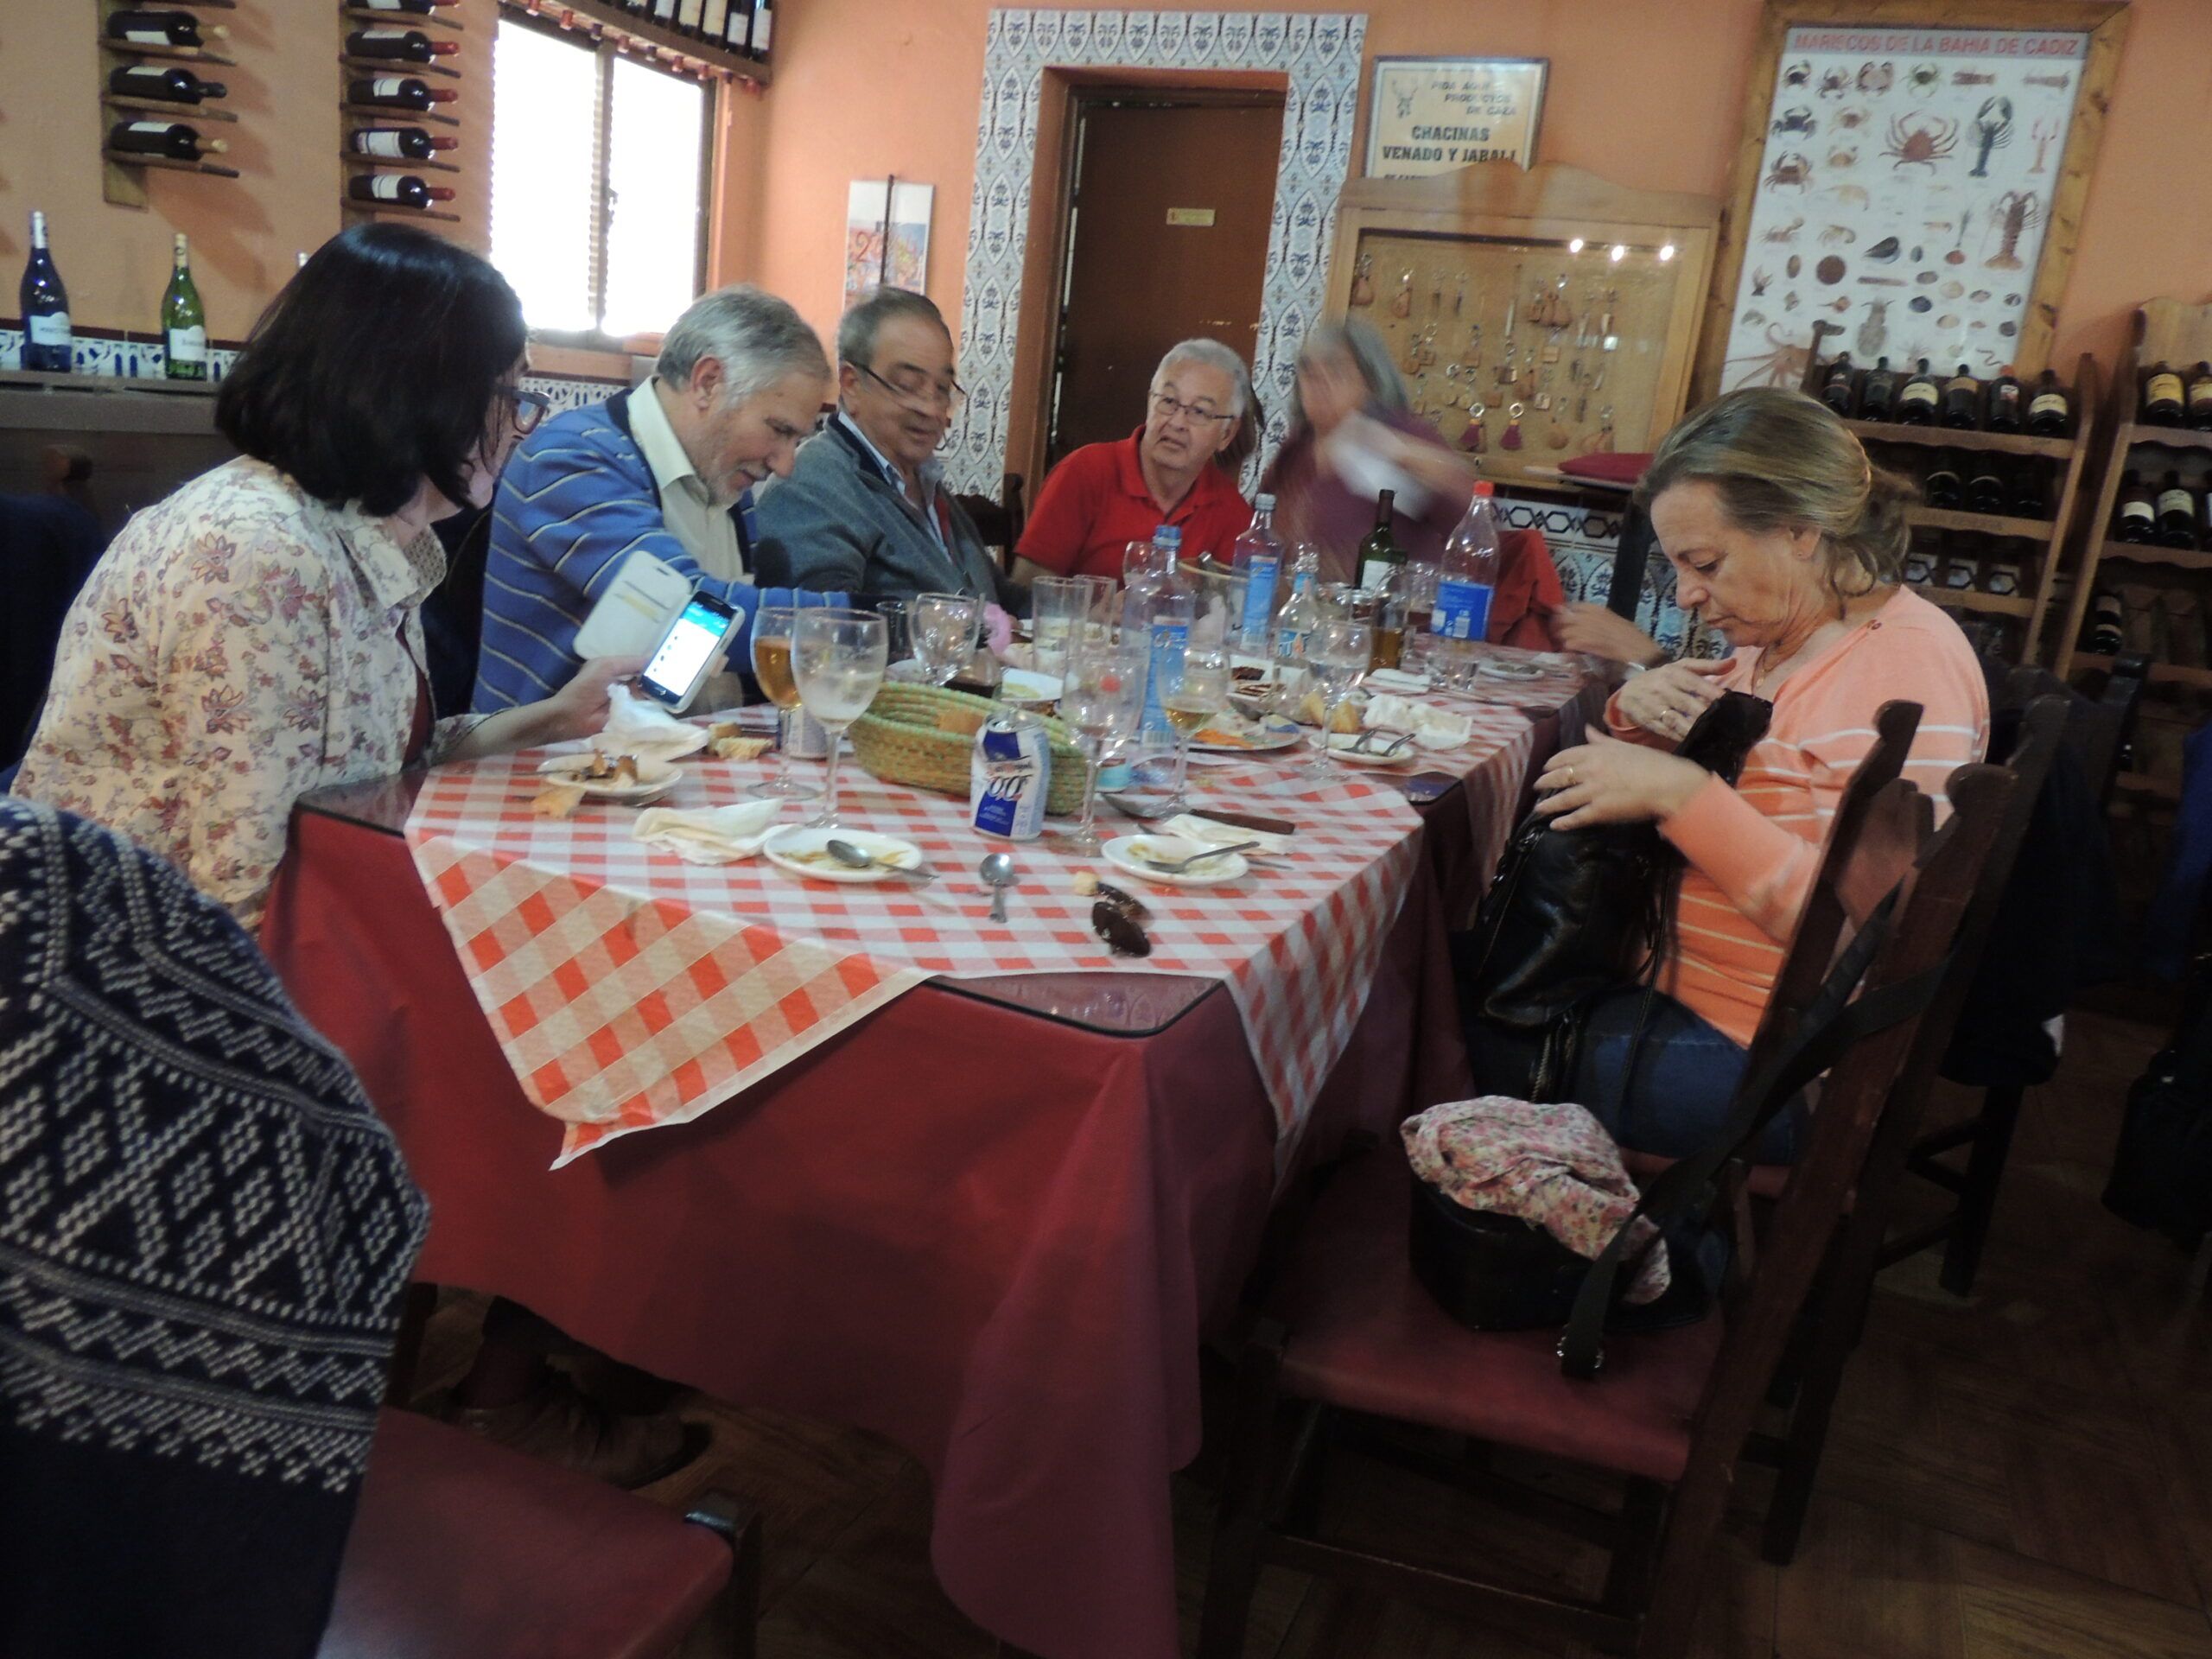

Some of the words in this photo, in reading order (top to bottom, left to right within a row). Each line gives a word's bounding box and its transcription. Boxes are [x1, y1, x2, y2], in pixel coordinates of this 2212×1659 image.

[1885, 35, 1909, 52] DE
[1911, 36, 1935, 53] LA
[1994, 37, 2019, 54] DE
[1411, 124, 1491, 142] CHACINAS
[1382, 145, 1442, 161] VENADO
[1448, 148, 1459, 162] Y
